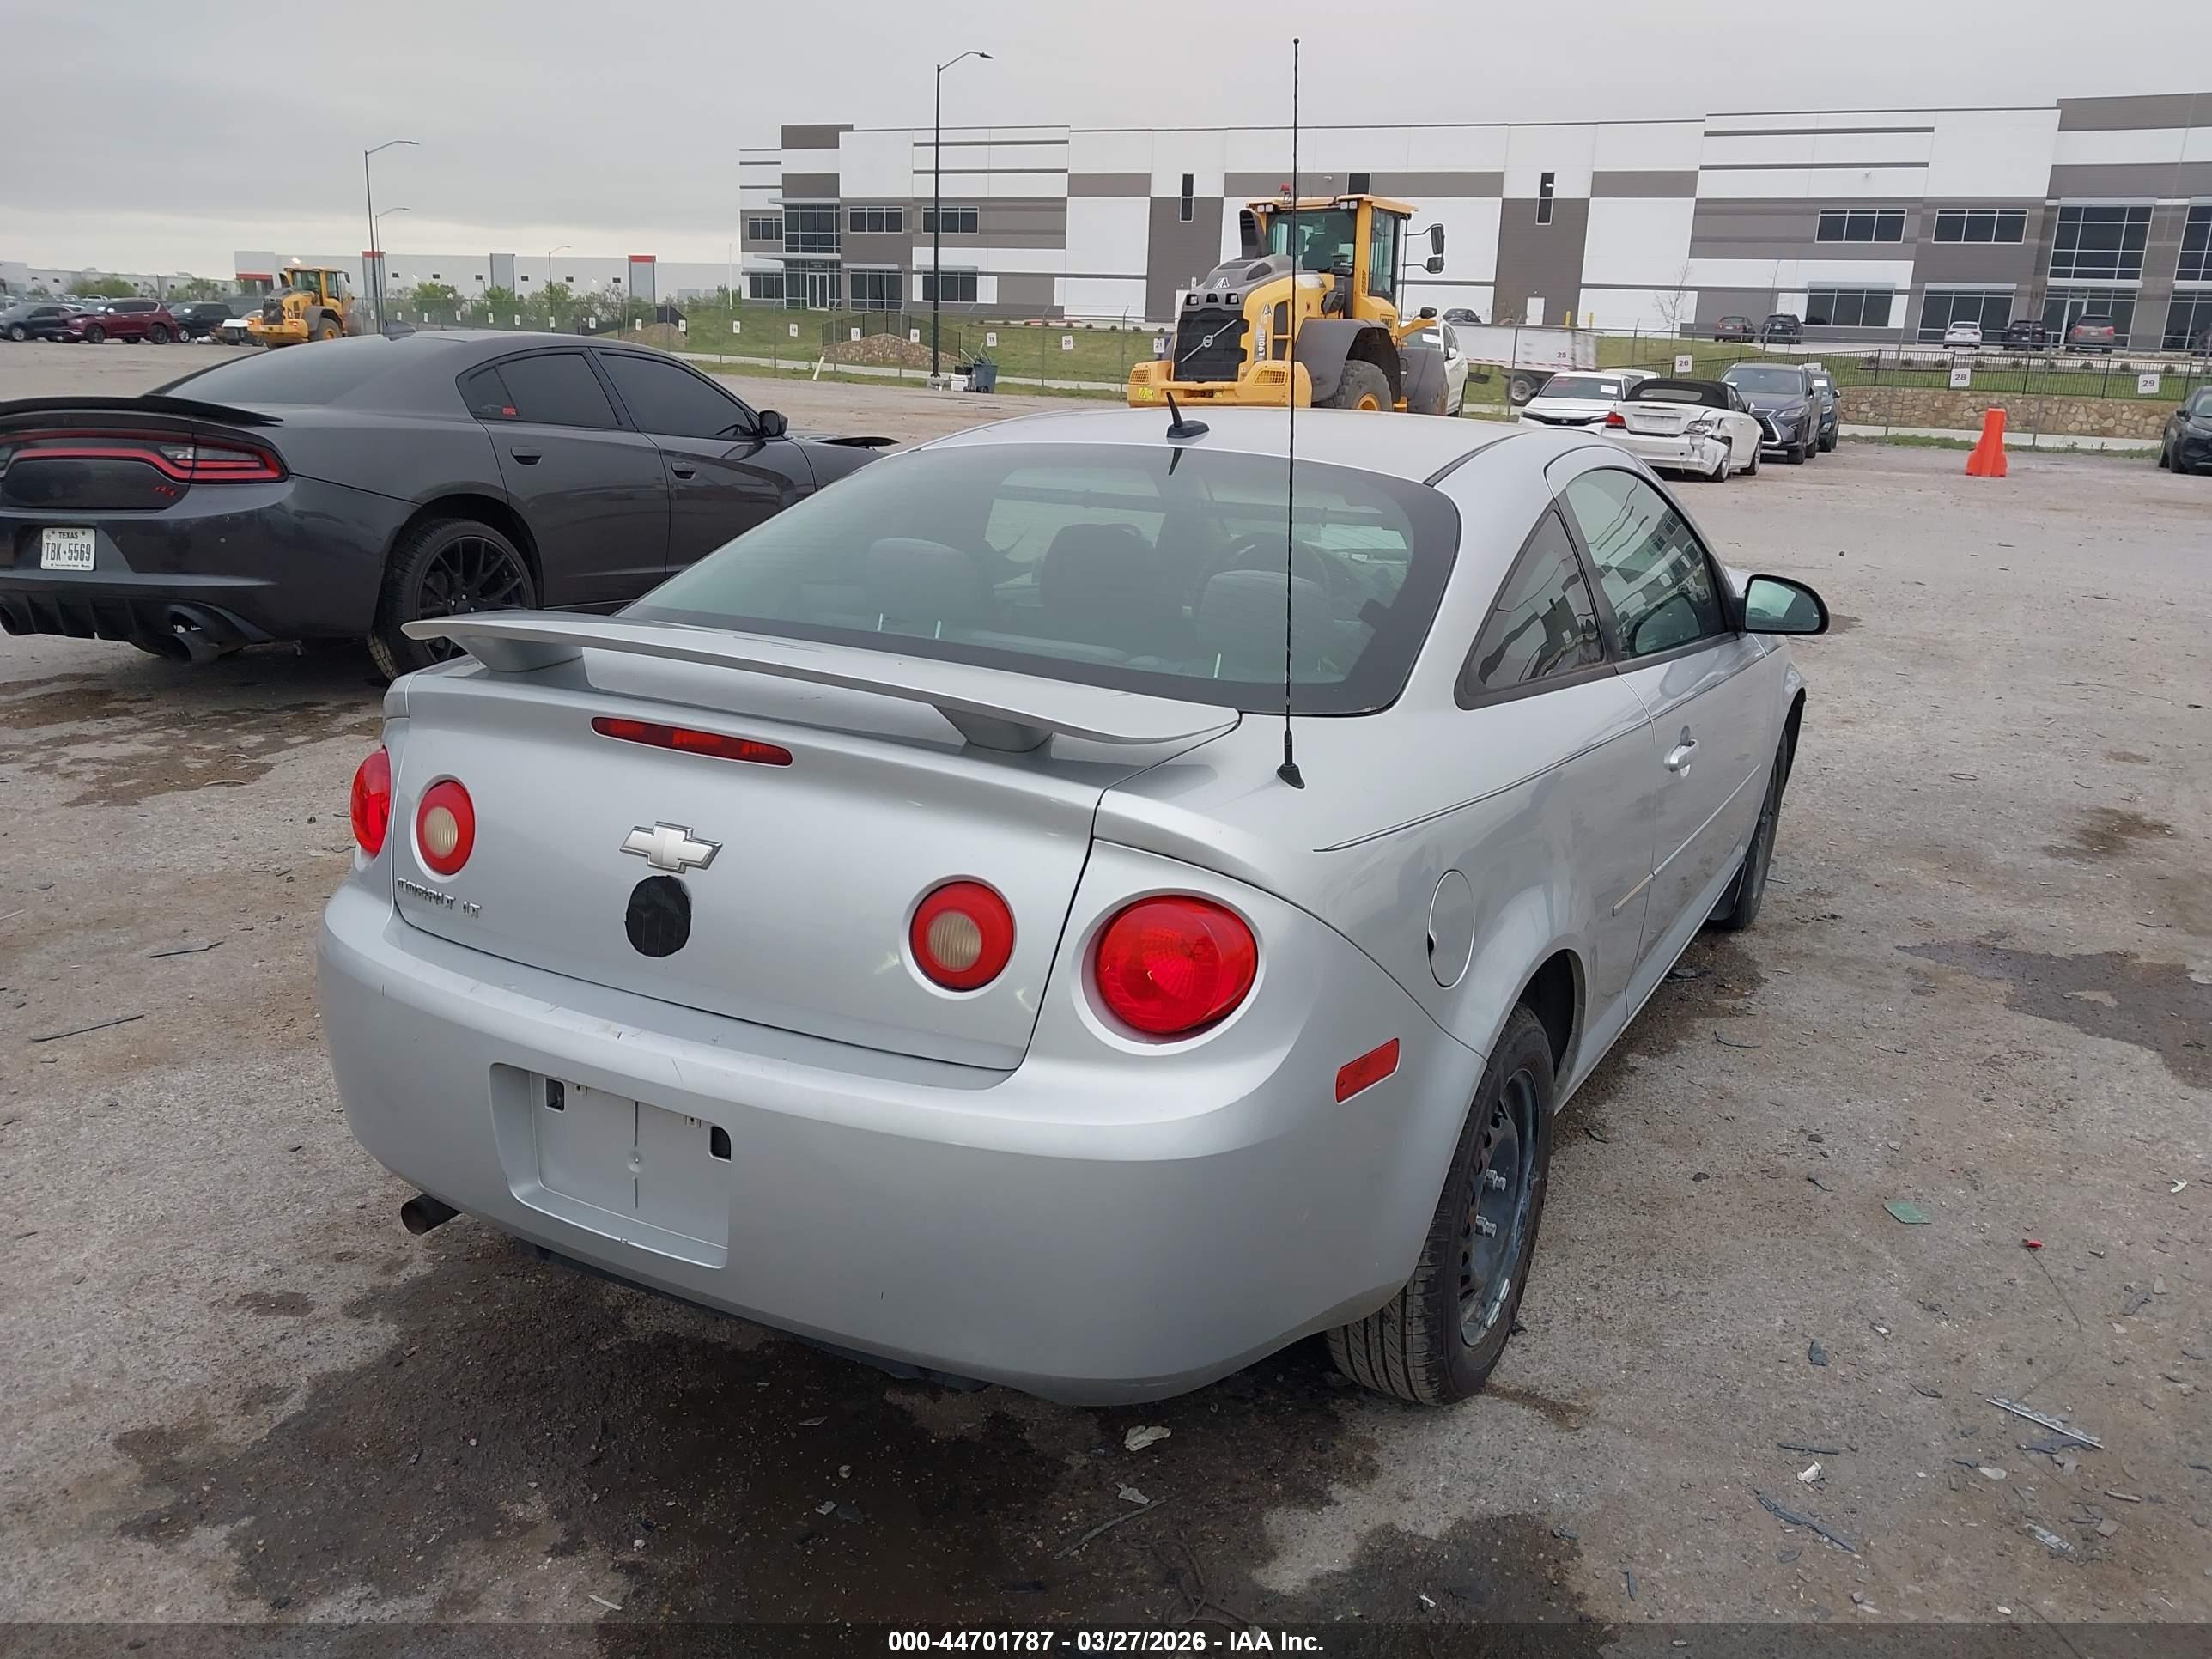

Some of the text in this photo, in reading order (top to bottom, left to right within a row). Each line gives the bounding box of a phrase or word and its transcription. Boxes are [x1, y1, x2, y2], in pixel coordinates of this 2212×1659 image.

[1954, 373, 1966, 381] 28
[2142, 379, 2155, 387] 29
[58, 531, 79, 540] TEXAS
